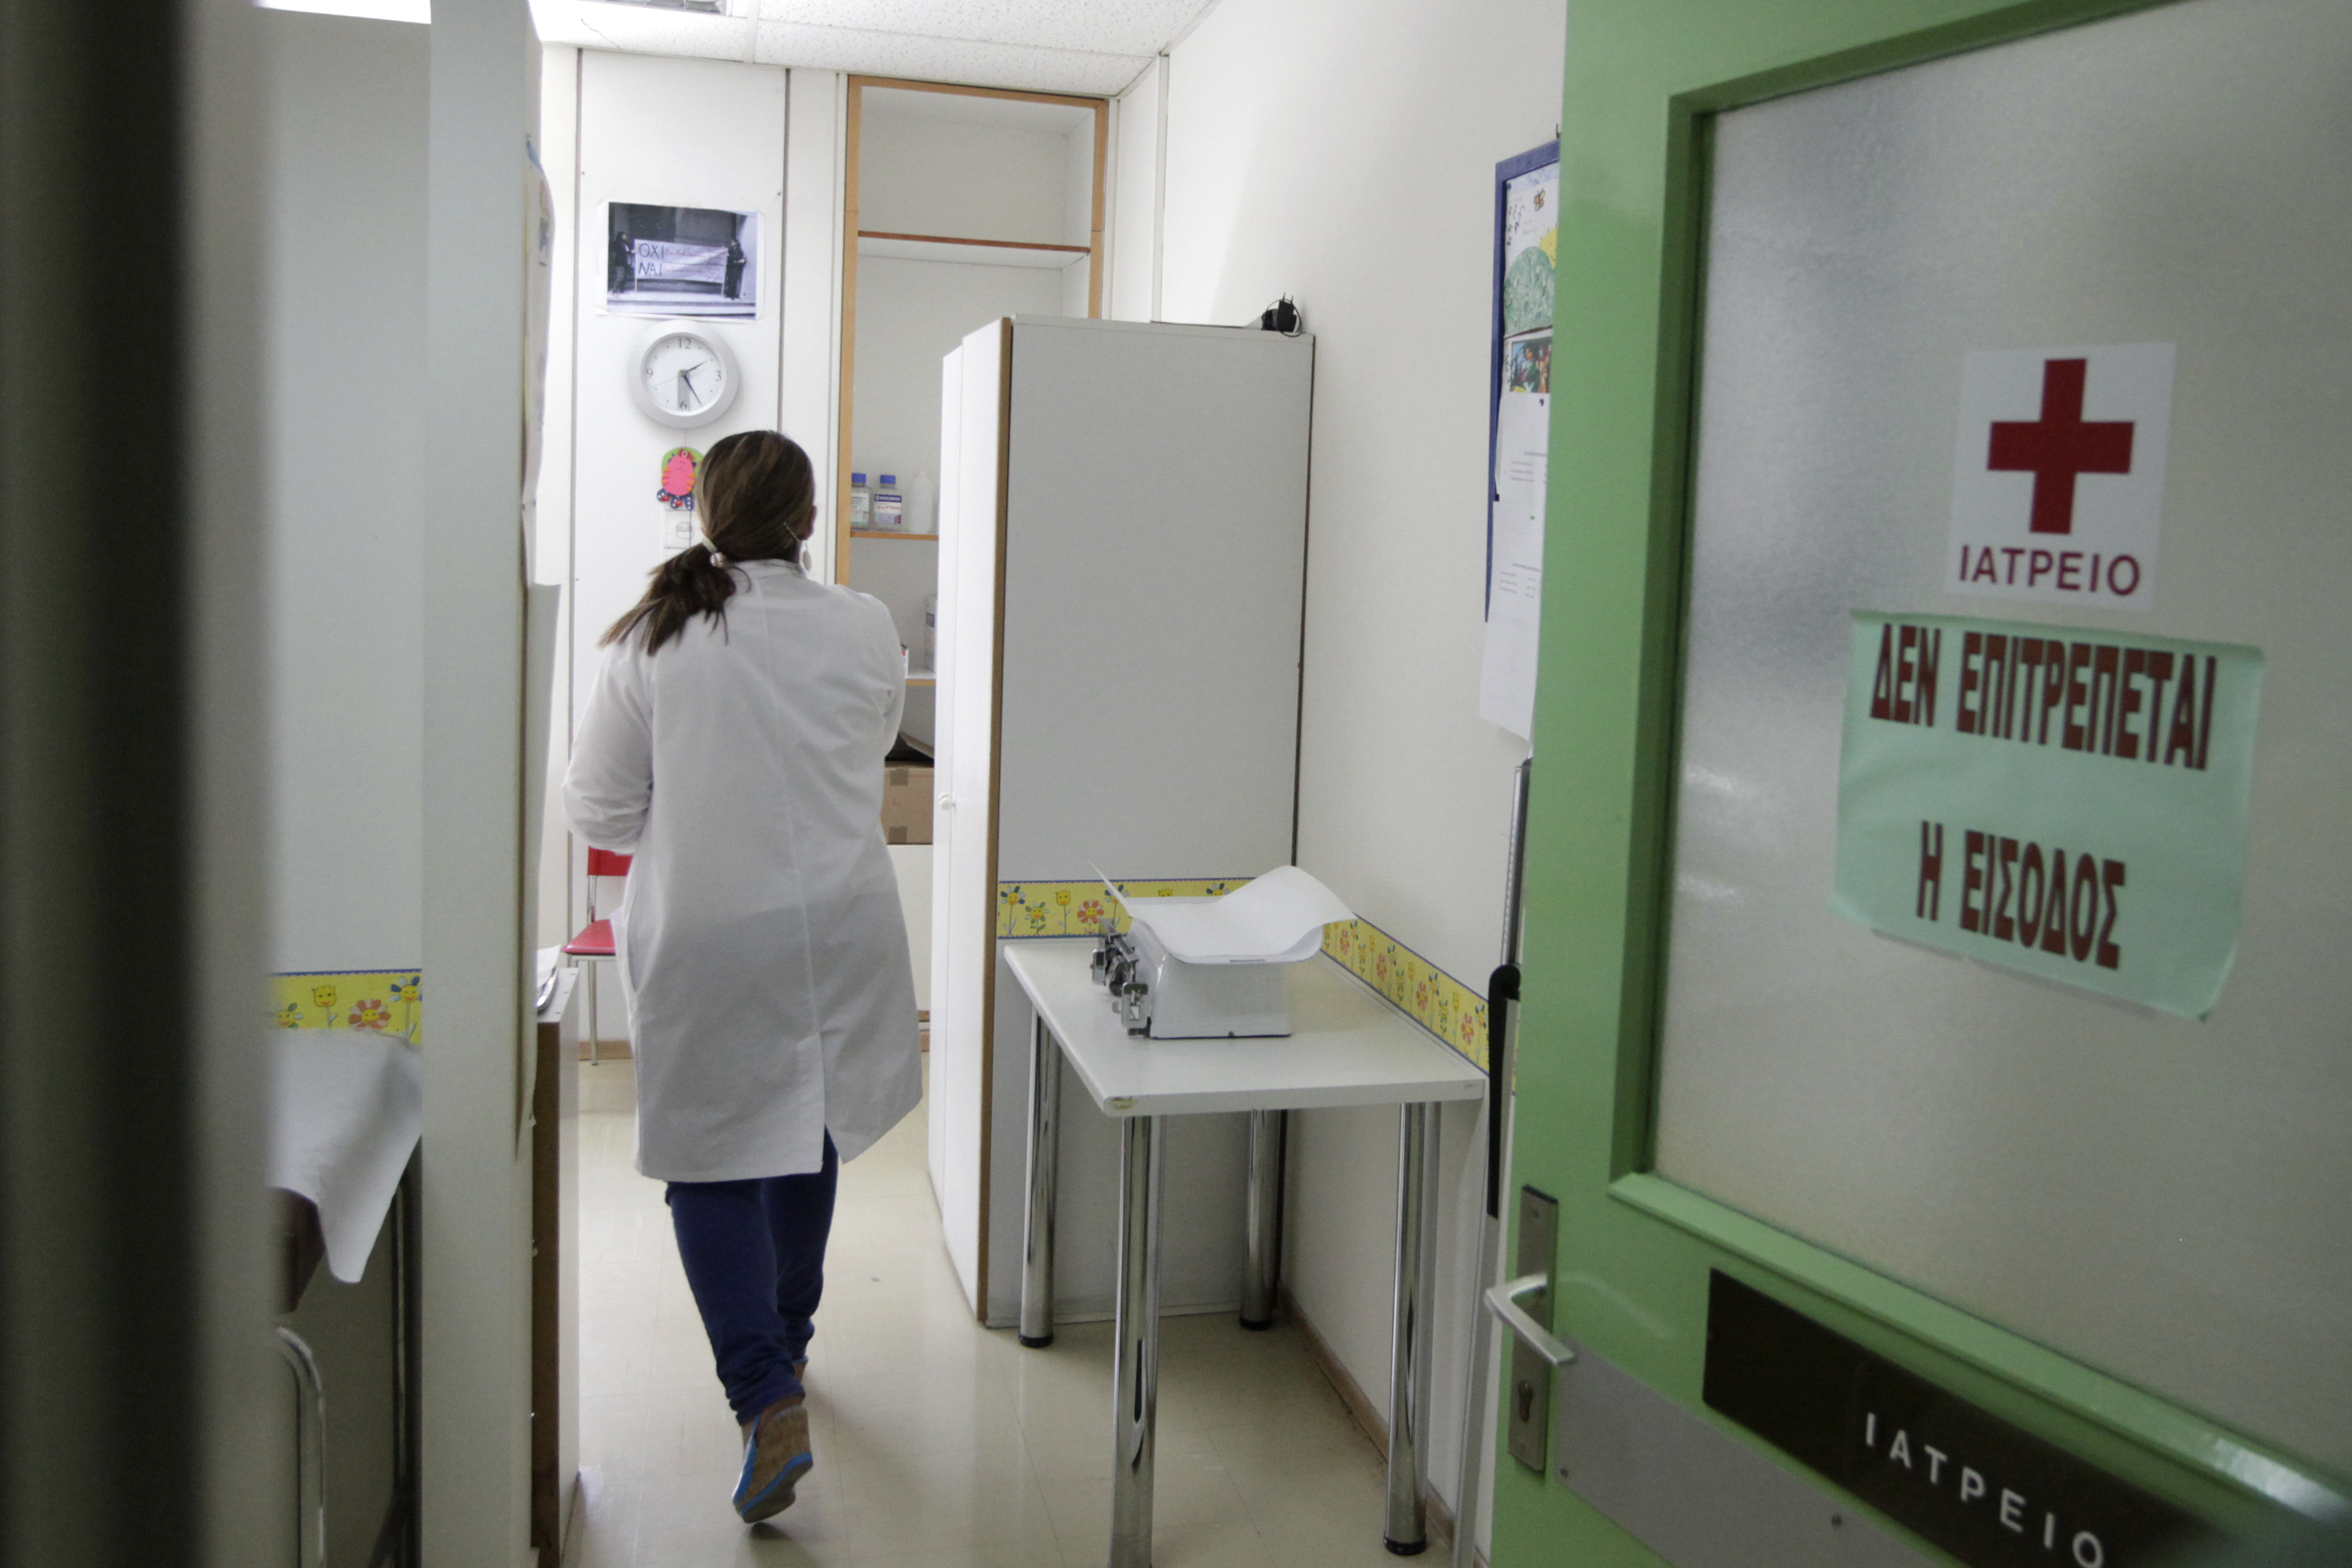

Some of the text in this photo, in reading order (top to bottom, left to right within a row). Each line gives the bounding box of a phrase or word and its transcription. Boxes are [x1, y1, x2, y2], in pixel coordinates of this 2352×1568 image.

[678, 339, 692, 350] 12
[646, 368, 654, 378] 9
[715, 370, 722, 381] 3
[680, 400, 687, 411] 6
[1959, 545, 2141, 596] ΙΑΤΡΕΙΟ
[1870, 622, 2216, 770] ΔΕΝ ΕΠΙΤΡΕΠΕΤΑΙ
[1916, 820, 2126, 970] Η ΕΙΣΟΔΟΣ
[1865, 1412, 2105, 1568] ΙΑΤΡΕΙΟ
